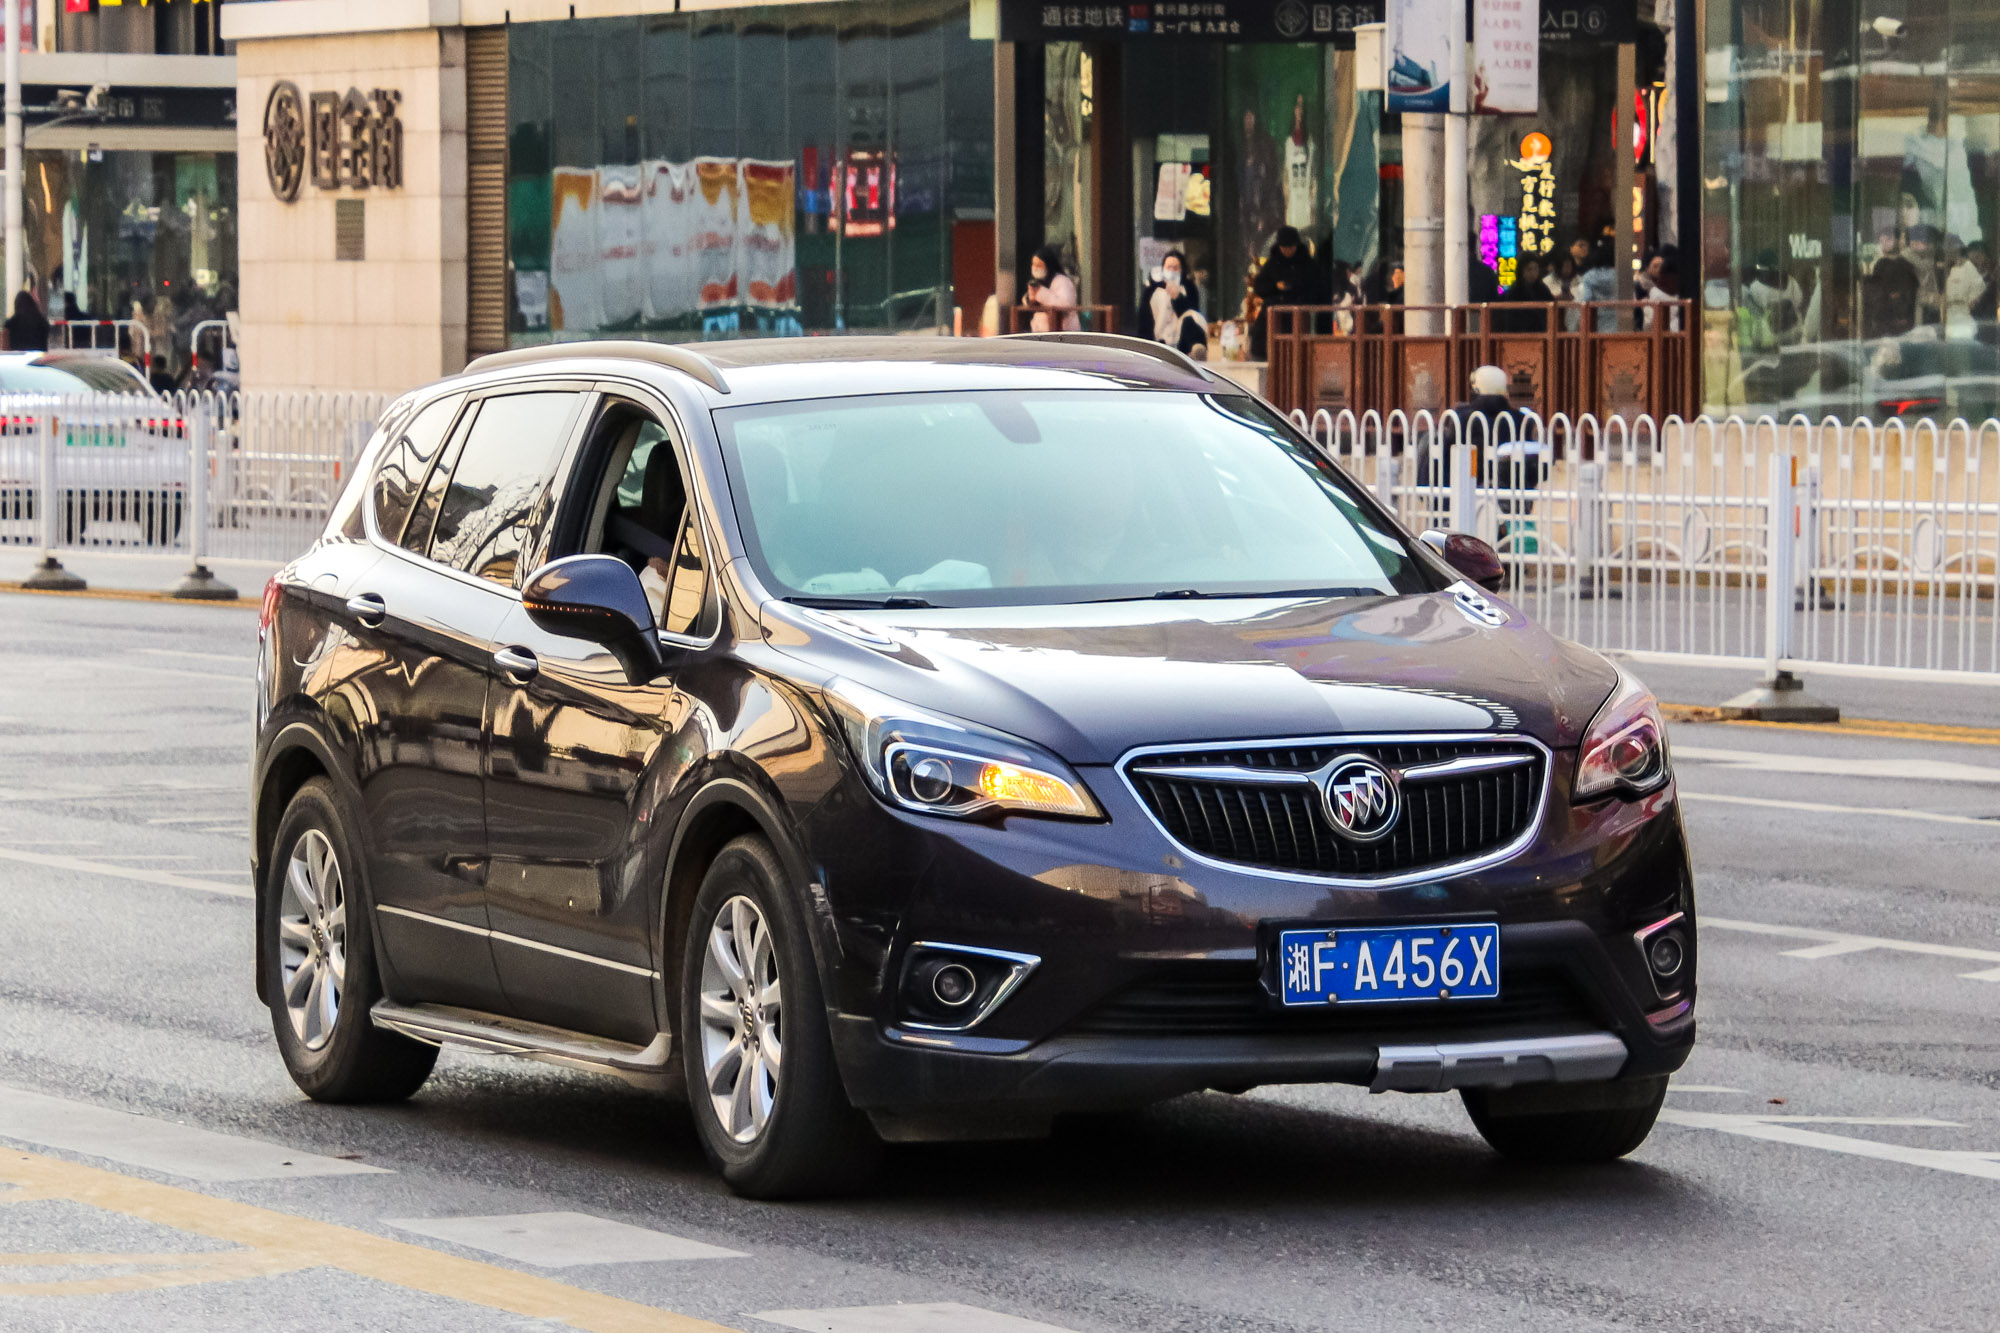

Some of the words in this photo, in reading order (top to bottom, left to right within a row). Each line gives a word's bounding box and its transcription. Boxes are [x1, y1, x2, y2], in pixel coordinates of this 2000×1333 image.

[1042, 6, 1124, 27] 通往地铁
[1541, 10, 1578, 30] 入口
